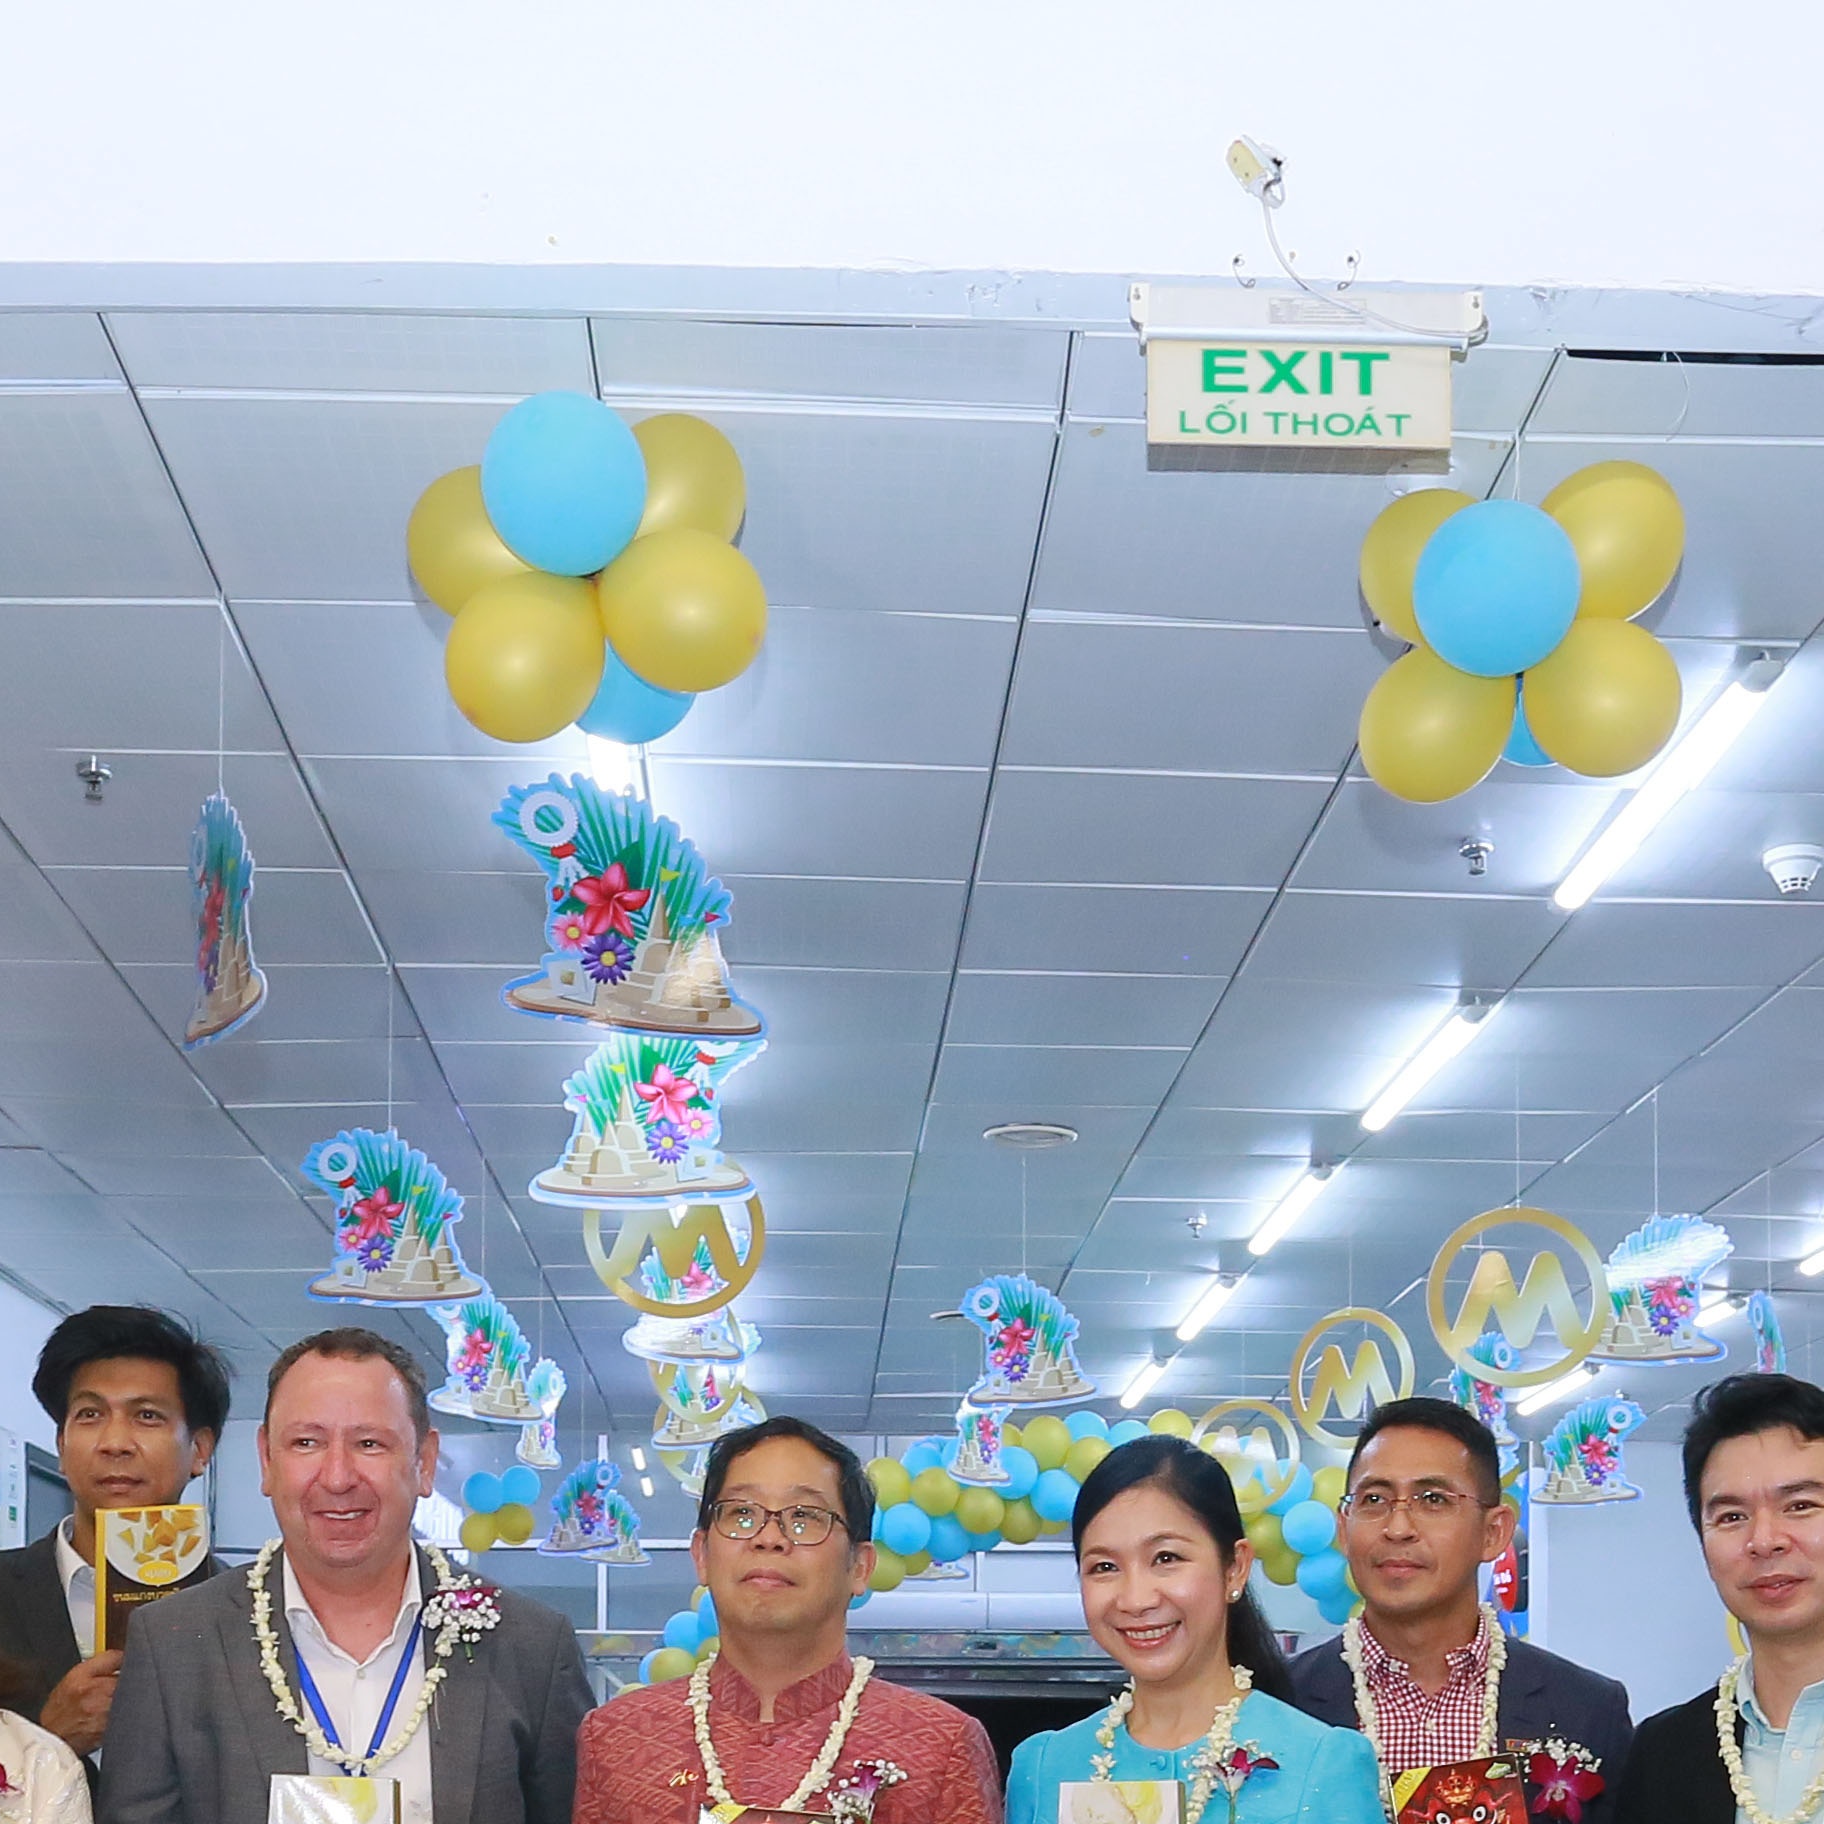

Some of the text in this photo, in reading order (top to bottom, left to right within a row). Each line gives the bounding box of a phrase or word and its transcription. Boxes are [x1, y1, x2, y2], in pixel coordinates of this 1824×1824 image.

[1201, 349, 1390, 395] EXIT
[1179, 398, 1412, 438] LỐI THOÁT
